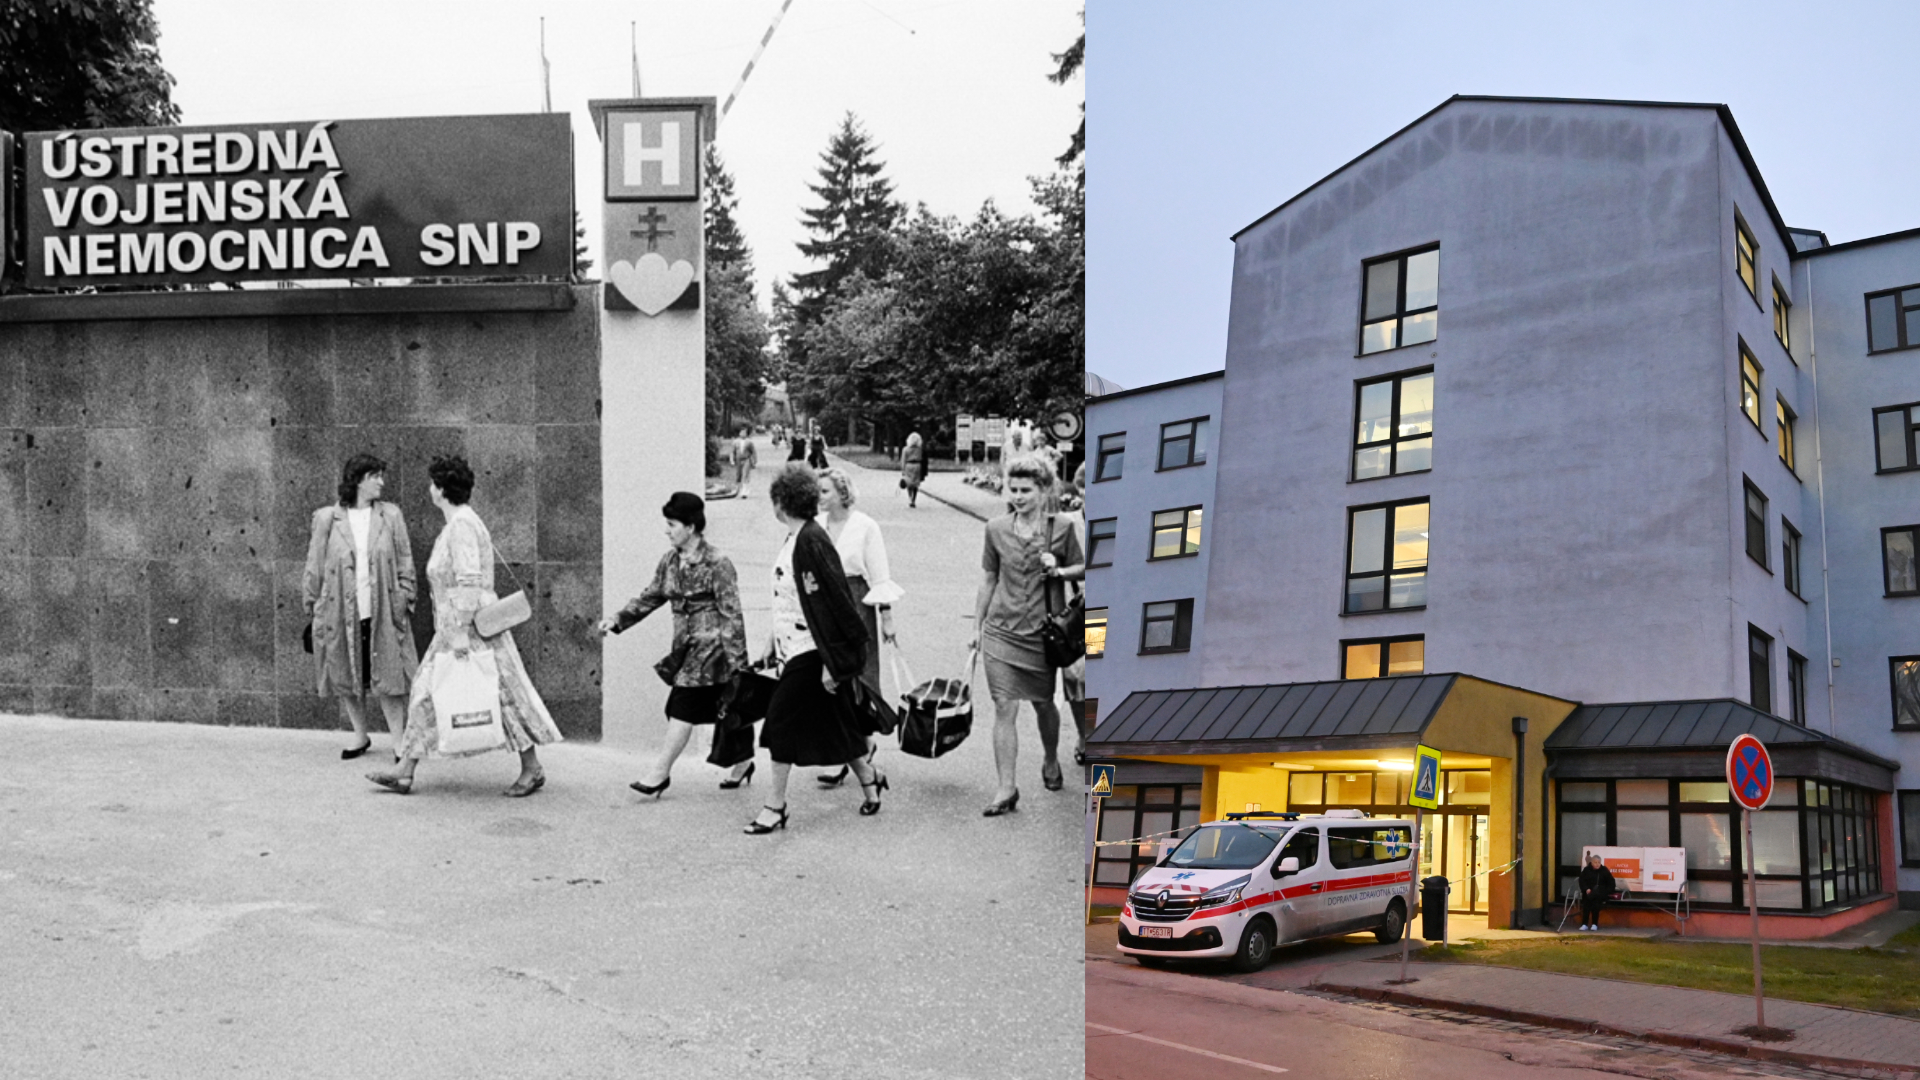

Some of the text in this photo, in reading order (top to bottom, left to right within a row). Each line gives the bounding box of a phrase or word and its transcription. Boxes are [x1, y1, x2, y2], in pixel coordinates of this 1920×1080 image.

[42, 121, 341, 179] ÚSTREDNÁ
[624, 122, 680, 186] H
[42, 170, 350, 228] VOJENSKÁ
[43, 221, 541, 277] NEMOCNICA SNP
